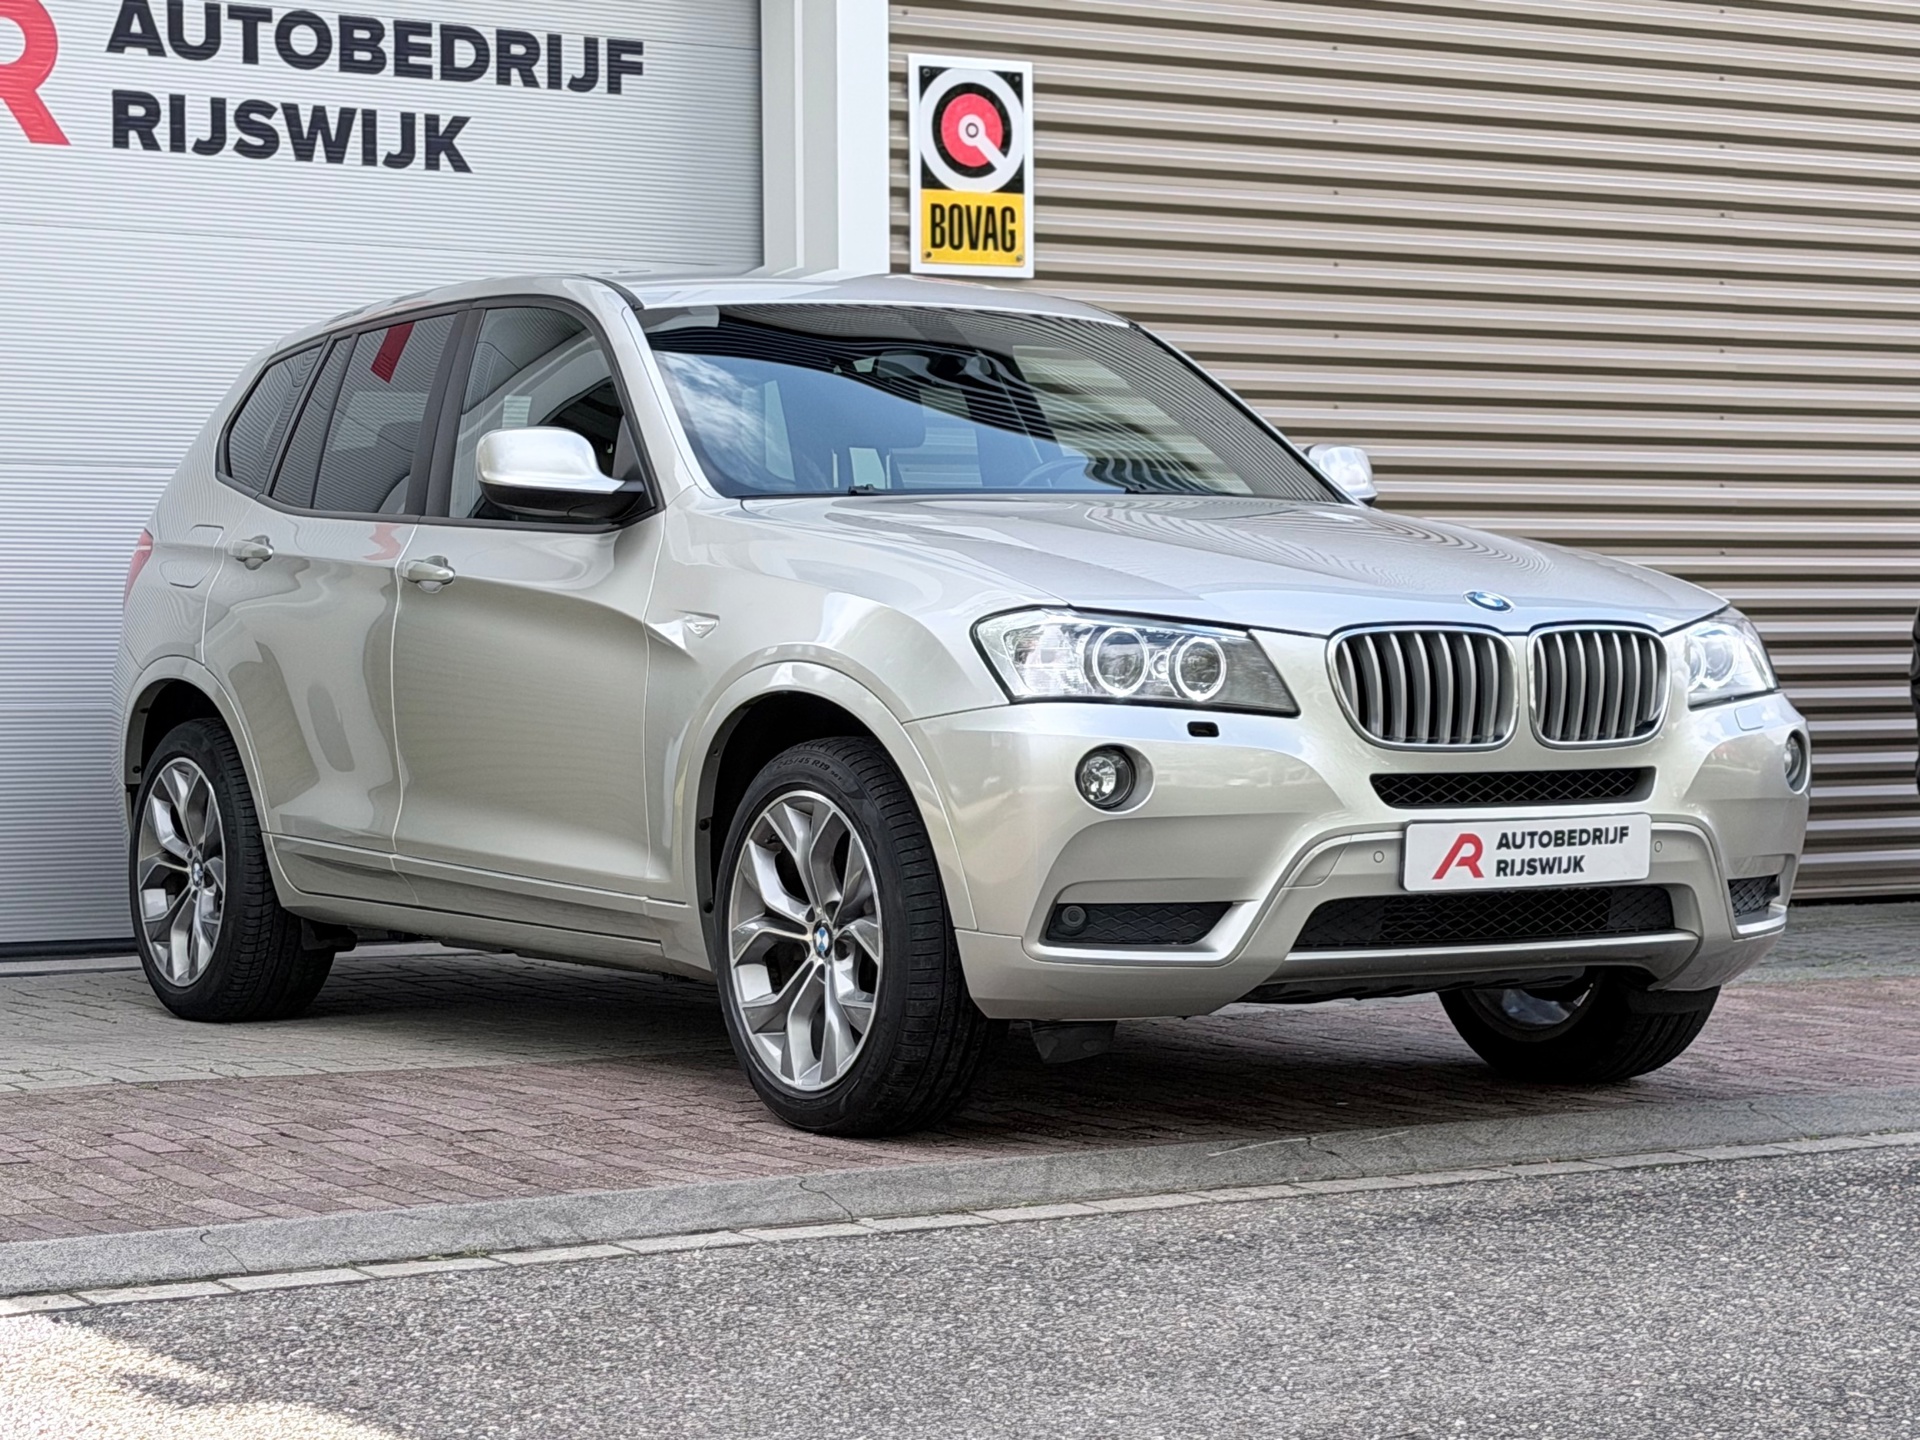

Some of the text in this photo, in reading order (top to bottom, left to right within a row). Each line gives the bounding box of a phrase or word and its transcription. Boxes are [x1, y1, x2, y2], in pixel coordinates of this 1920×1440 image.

[106, 0, 644, 95] AUTOBEDRIJF
[111, 89, 472, 173] RIJSWIJK
[930, 203, 1017, 253] BOVAG
[1496, 826, 1629, 850] AUTOBEDRIJF
[1495, 855, 1585, 877] RIJSWIJK
